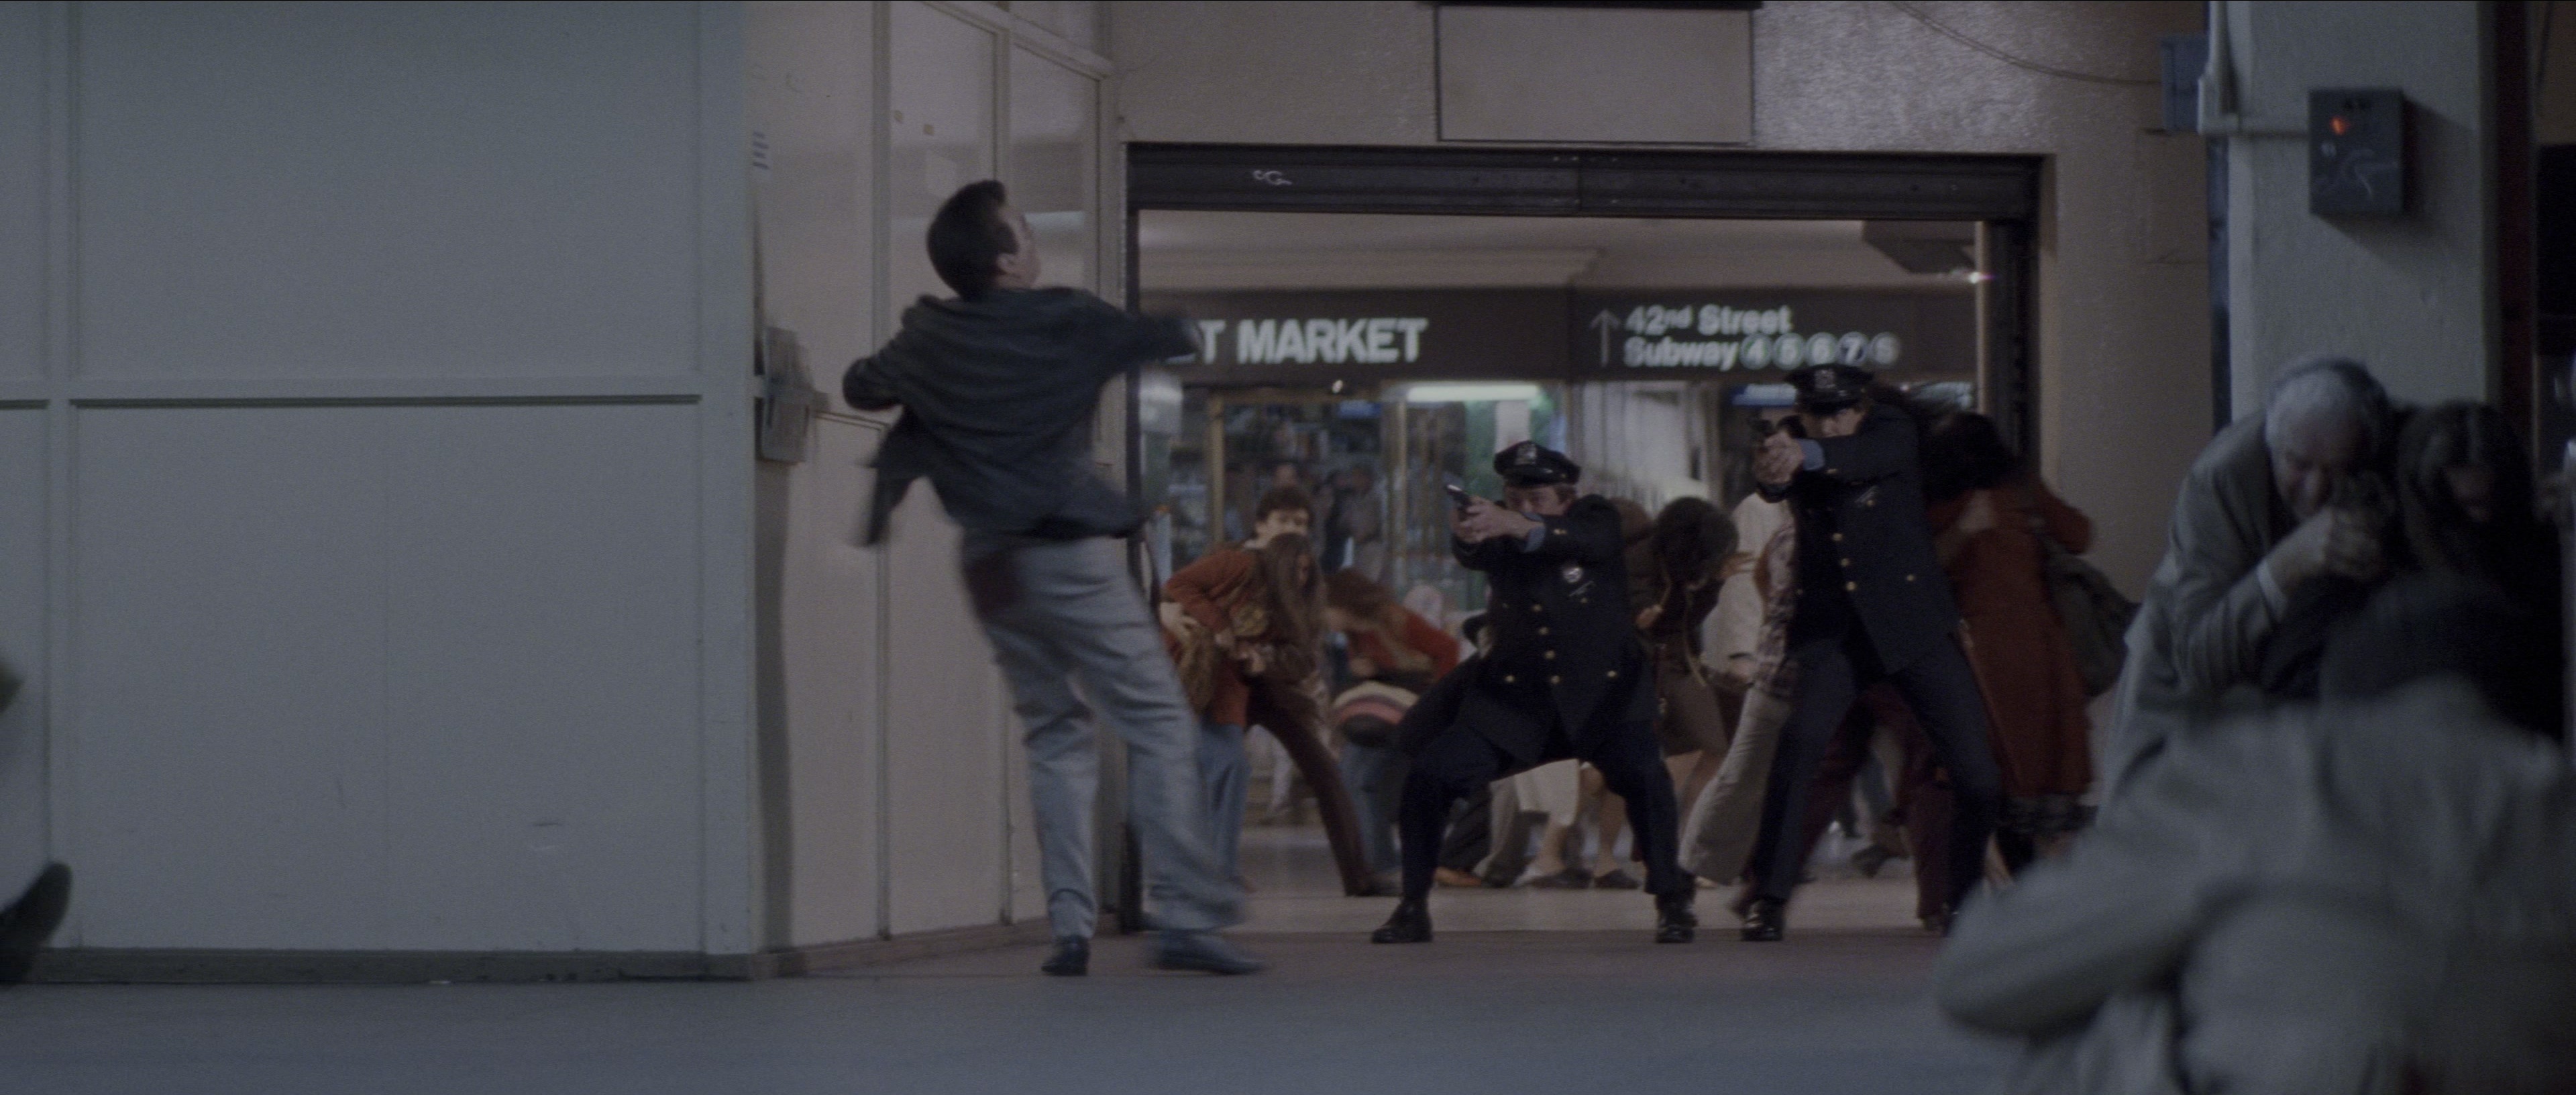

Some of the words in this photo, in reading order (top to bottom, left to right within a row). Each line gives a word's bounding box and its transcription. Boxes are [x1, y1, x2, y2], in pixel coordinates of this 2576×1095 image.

[1625, 305, 1693, 335] 42nd
[1698, 305, 1792, 335] Street
[1238, 318, 1428, 364] MARKET
[1624, 336, 1739, 371] Subway
